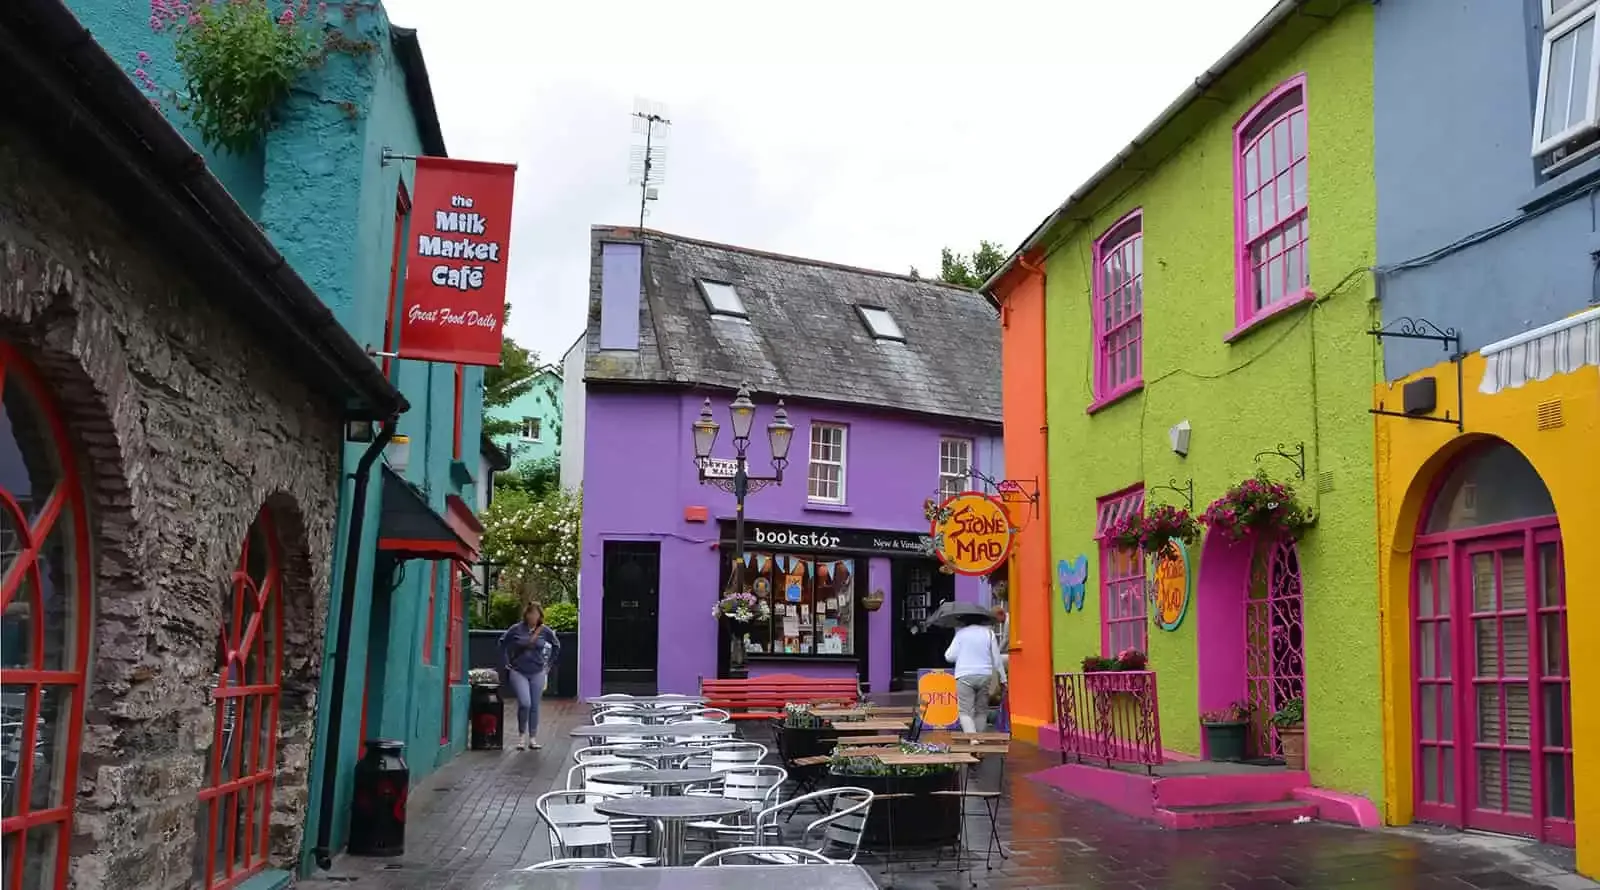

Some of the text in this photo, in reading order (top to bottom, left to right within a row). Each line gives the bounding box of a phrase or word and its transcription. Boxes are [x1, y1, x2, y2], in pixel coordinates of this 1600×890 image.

[451, 195, 473, 208] the
[435, 211, 486, 234] Milk
[418, 234, 500, 262] Market
[431, 264, 484, 291] Café
[408, 304, 497, 332] Great Food Daily
[949, 504, 1005, 537] STONE
[755, 527, 840, 548] bookstór
[873, 538, 924, 552] New & Vintag
[956, 538, 1003, 562] MAD
[920, 691, 959, 706] OPEN
